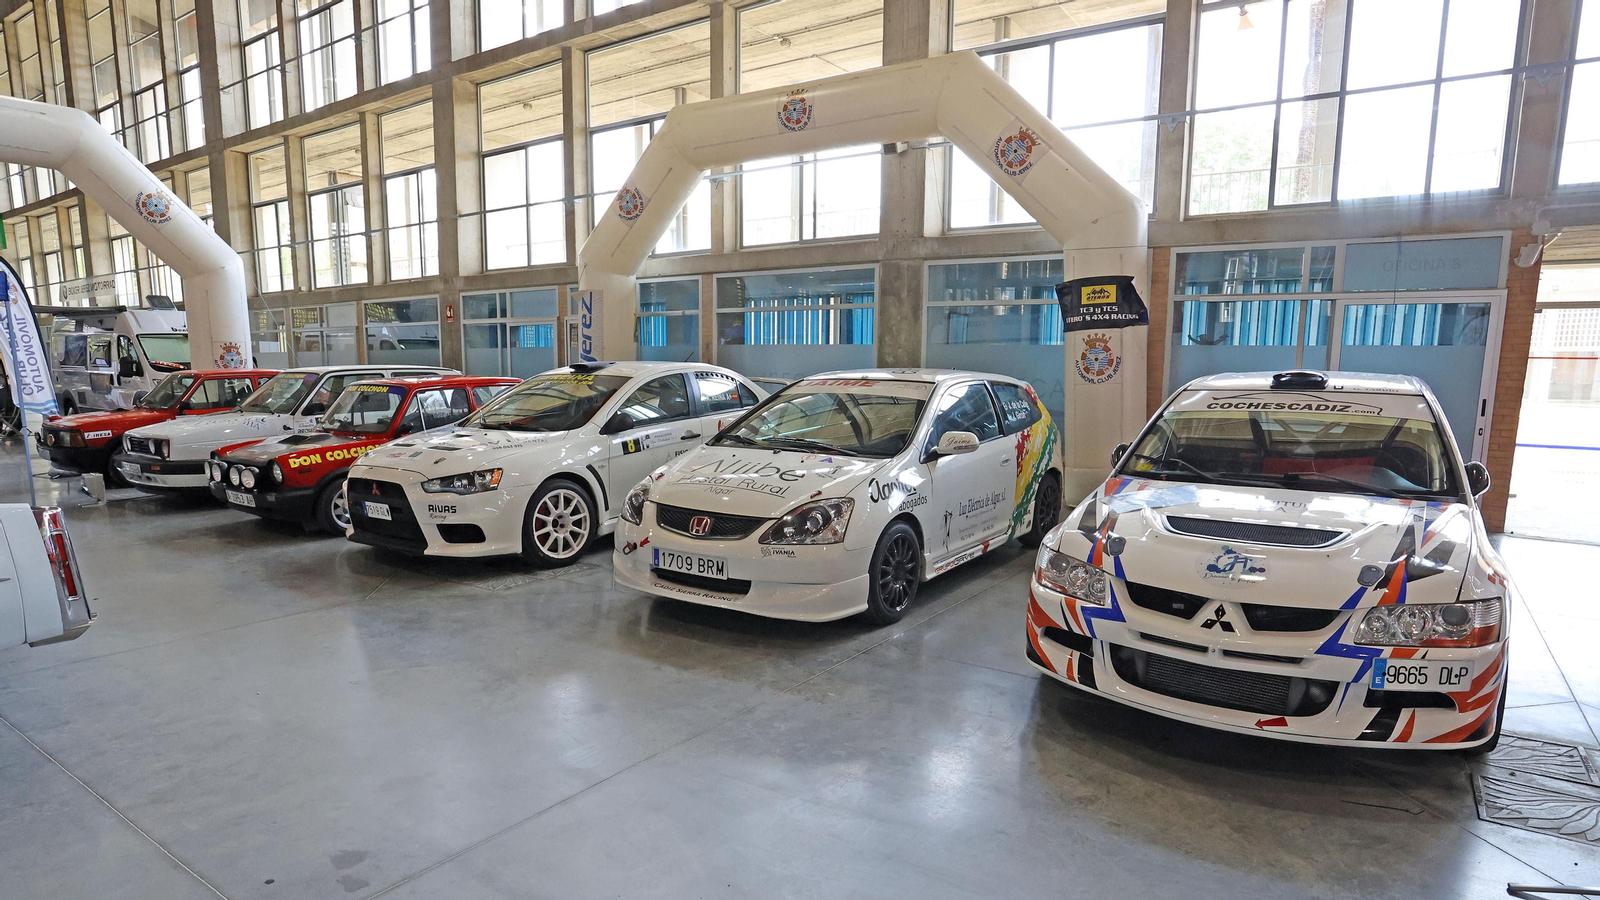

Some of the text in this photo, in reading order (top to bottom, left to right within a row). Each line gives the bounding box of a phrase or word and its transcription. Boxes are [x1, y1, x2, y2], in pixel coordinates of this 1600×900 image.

[797, 121, 808, 132] CLUB
[994, 137, 1033, 176] AUTOMOVIL CLUB JEREZ
[1383, 258, 1446, 272] OFICINA
[1074, 356, 1122, 384] AUTOMOVIL CLUB JEREZ
[627, 439, 636, 452] 8
[946, 436, 971, 447] Jaime
[288, 454, 322, 468] DON
[326, 444, 381, 461] COLCHO
[704, 486, 736, 496] Algar
[736, 479, 791, 496] Rural
[898, 493, 928, 512] abogados
[429, 513, 447, 522] Racing
[662, 552, 724, 576] 1709 BRM
[1386, 665, 1468, 685] 9665 DLP
